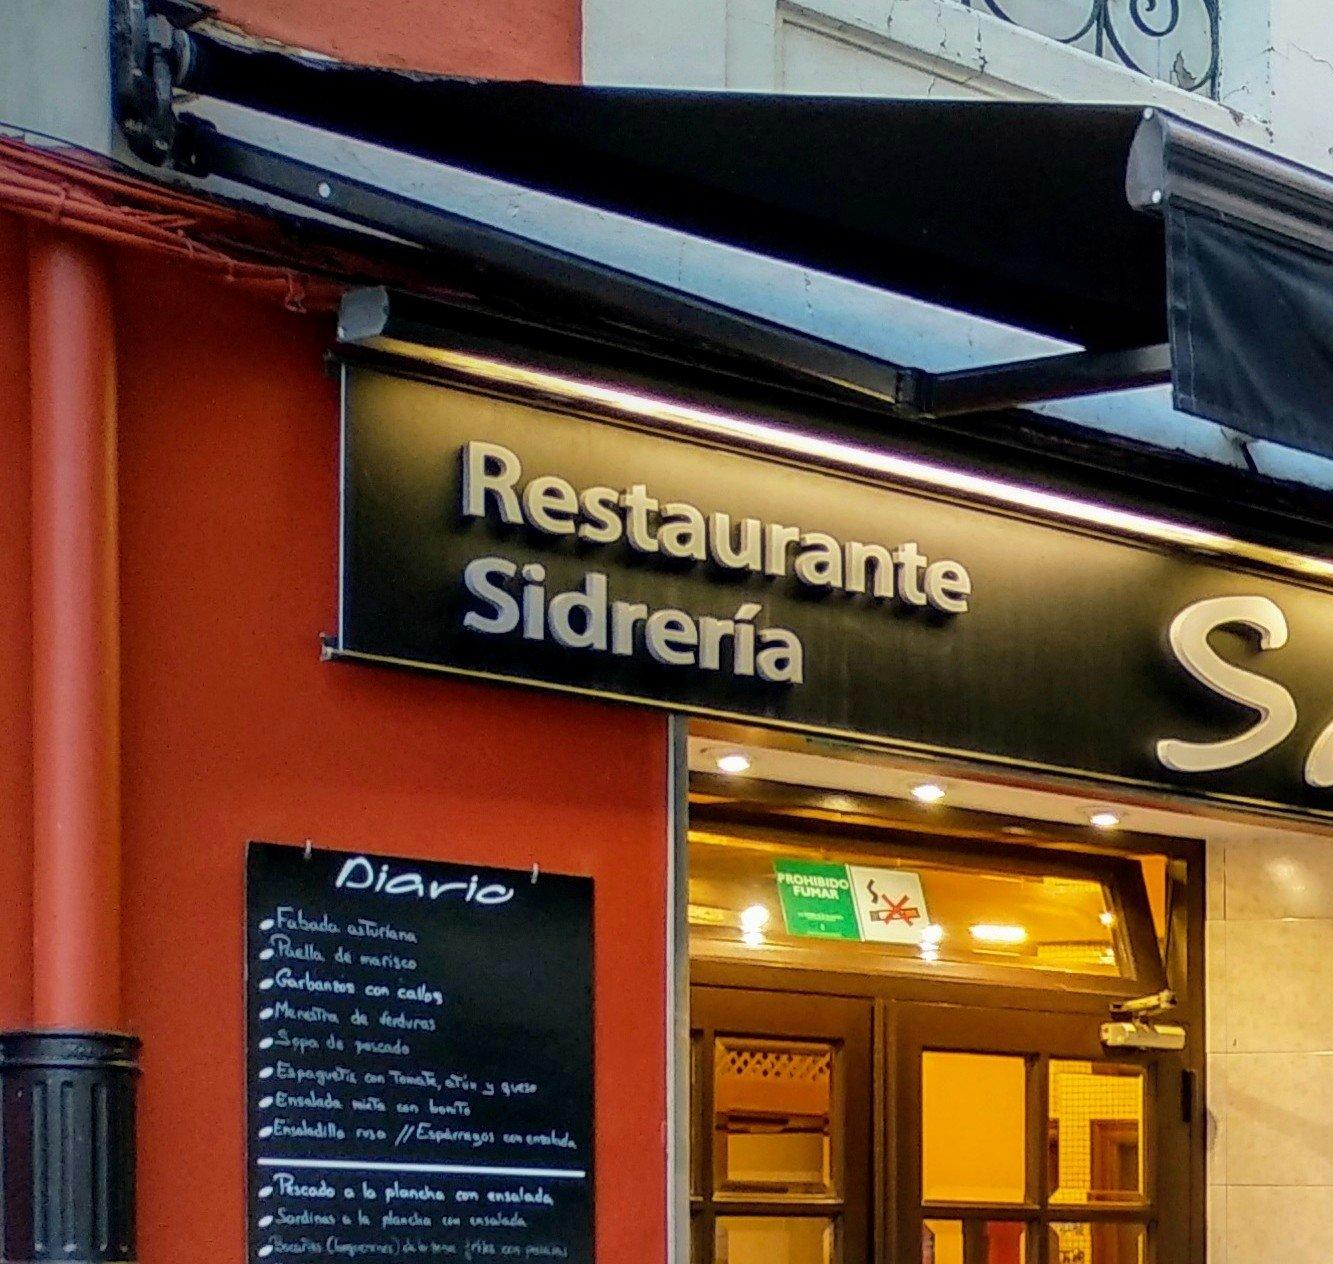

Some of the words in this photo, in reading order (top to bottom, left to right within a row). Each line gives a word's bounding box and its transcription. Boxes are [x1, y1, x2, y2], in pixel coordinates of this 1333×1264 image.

[460, 440, 973, 614] Restaurante
[460, 555, 805, 687] Sidrería
[334, 857, 514, 905] Diario
[778, 873, 849, 891] PROHIBIDO
[793, 886, 839, 900] FUMAR
[276, 906, 341, 934] Fabada
[270, 933, 325, 962] Paella
[335, 946, 351, 964] de
[360, 954, 417, 971] marisco
[275, 967, 355, 994] Garbanzos
[365, 984, 389, 997] con
[397, 983, 443, 1005] callos
[351, 1008, 369, 1026] de
[326, 1032, 344, 1051] de
[364, 1073, 386, 1084] con
[275, 1090, 344, 1110] Ensalada
[396, 1103, 419, 1114] con
[272, 1172, 336, 1199] Pescado
[344, 1187, 355, 1199] a
[362, 1181, 377, 1199] la
[385, 1180, 445, 1204] plancha
[455, 1190, 479, 1202] con
[487, 1186, 554, 1206] ensalada
[358, 1209, 370, 1225] la
[382, 1209, 432, 1229] plancha
[442, 1216, 461, 1226] con
[469, 1212, 528, 1227] ensalada
